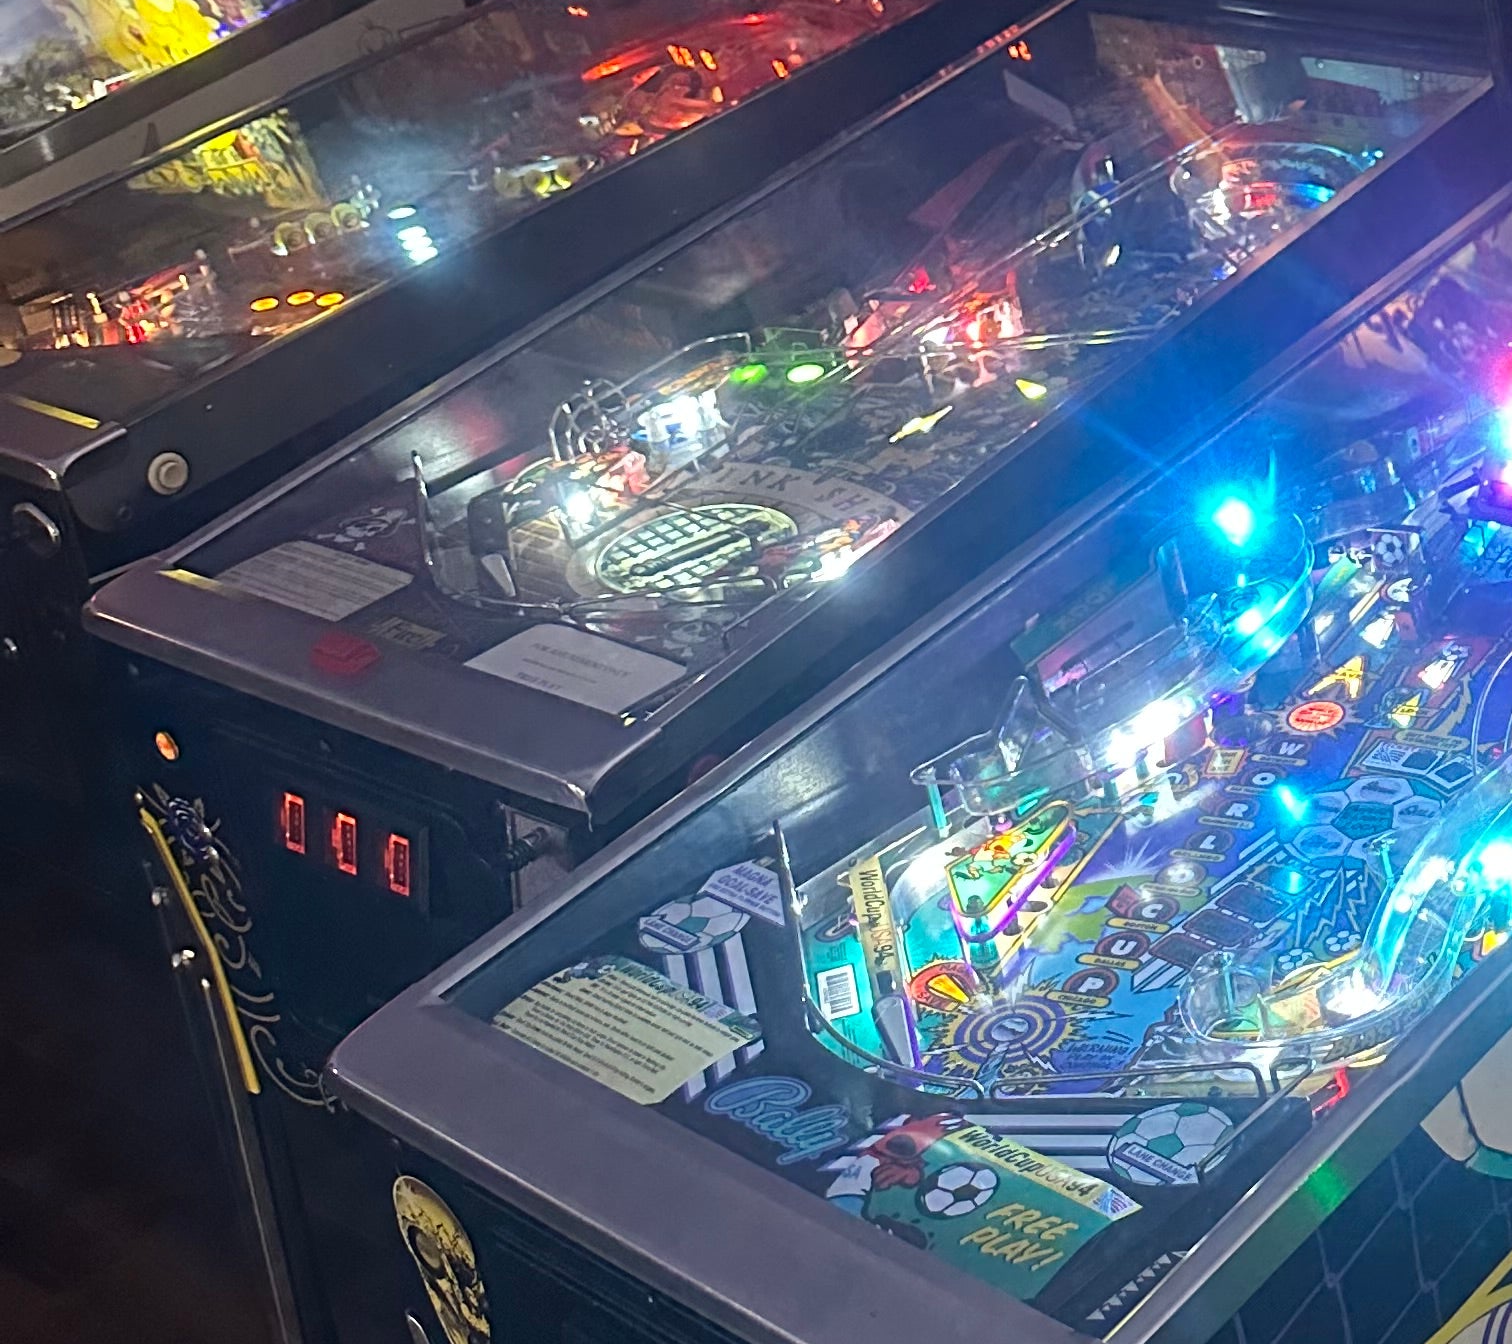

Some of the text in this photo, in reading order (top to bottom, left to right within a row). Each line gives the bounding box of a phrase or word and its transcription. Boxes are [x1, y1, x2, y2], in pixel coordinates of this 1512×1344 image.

[1279, 741, 1305, 756] W
[1251, 772, 1276, 786] O
[1225, 802, 1249, 818] R
[1199, 835, 1217, 850] L
[717, 874, 779, 906] GOAL-SAVE
[732, 863, 776, 889] MAGNA
[1077, 904, 1163, 995] C U P
[706, 1075, 851, 1165] Bally
[1131, 1145, 1194, 1182] LANE CHANGE
[985, 1202, 1080, 1241] FREE
[959, 1225, 1065, 1272] PLAY!
